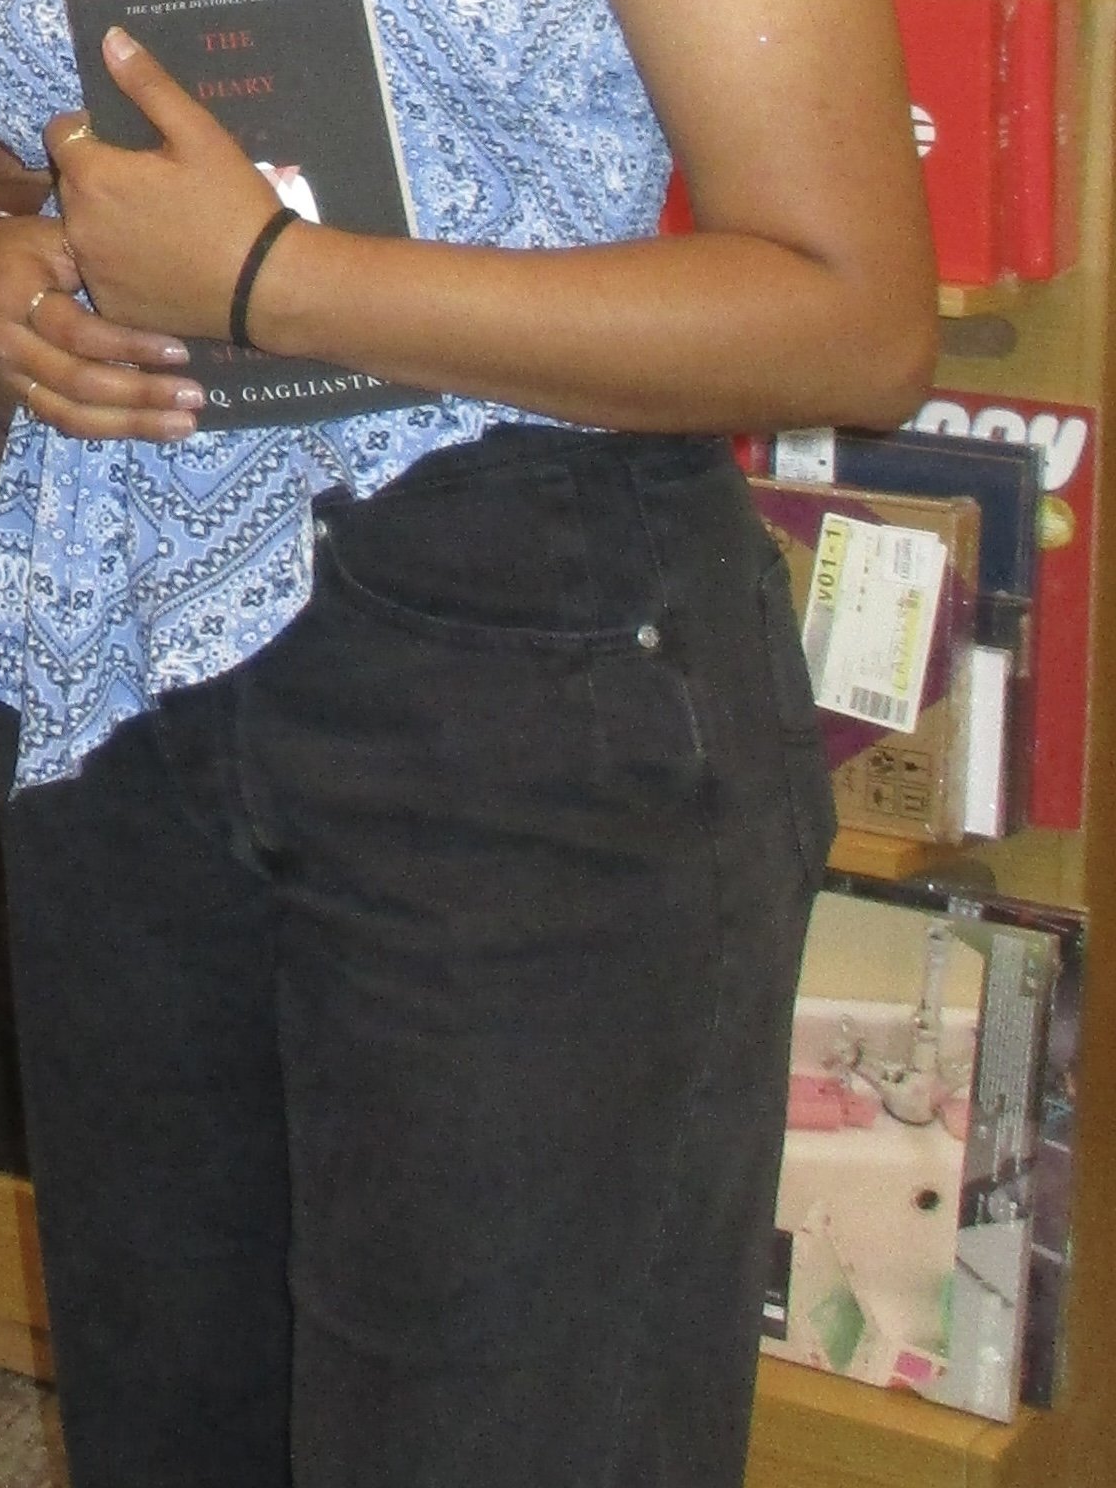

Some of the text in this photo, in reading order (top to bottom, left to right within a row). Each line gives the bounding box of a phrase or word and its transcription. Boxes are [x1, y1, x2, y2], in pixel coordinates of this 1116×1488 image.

[125, 5, 148, 15] THE
[150, 1, 186, 13] QUEER
[200, 29, 255, 52] THE
[198, 74, 275, 98] DIARY
[242, 374, 390, 402] GAGLIASTR
